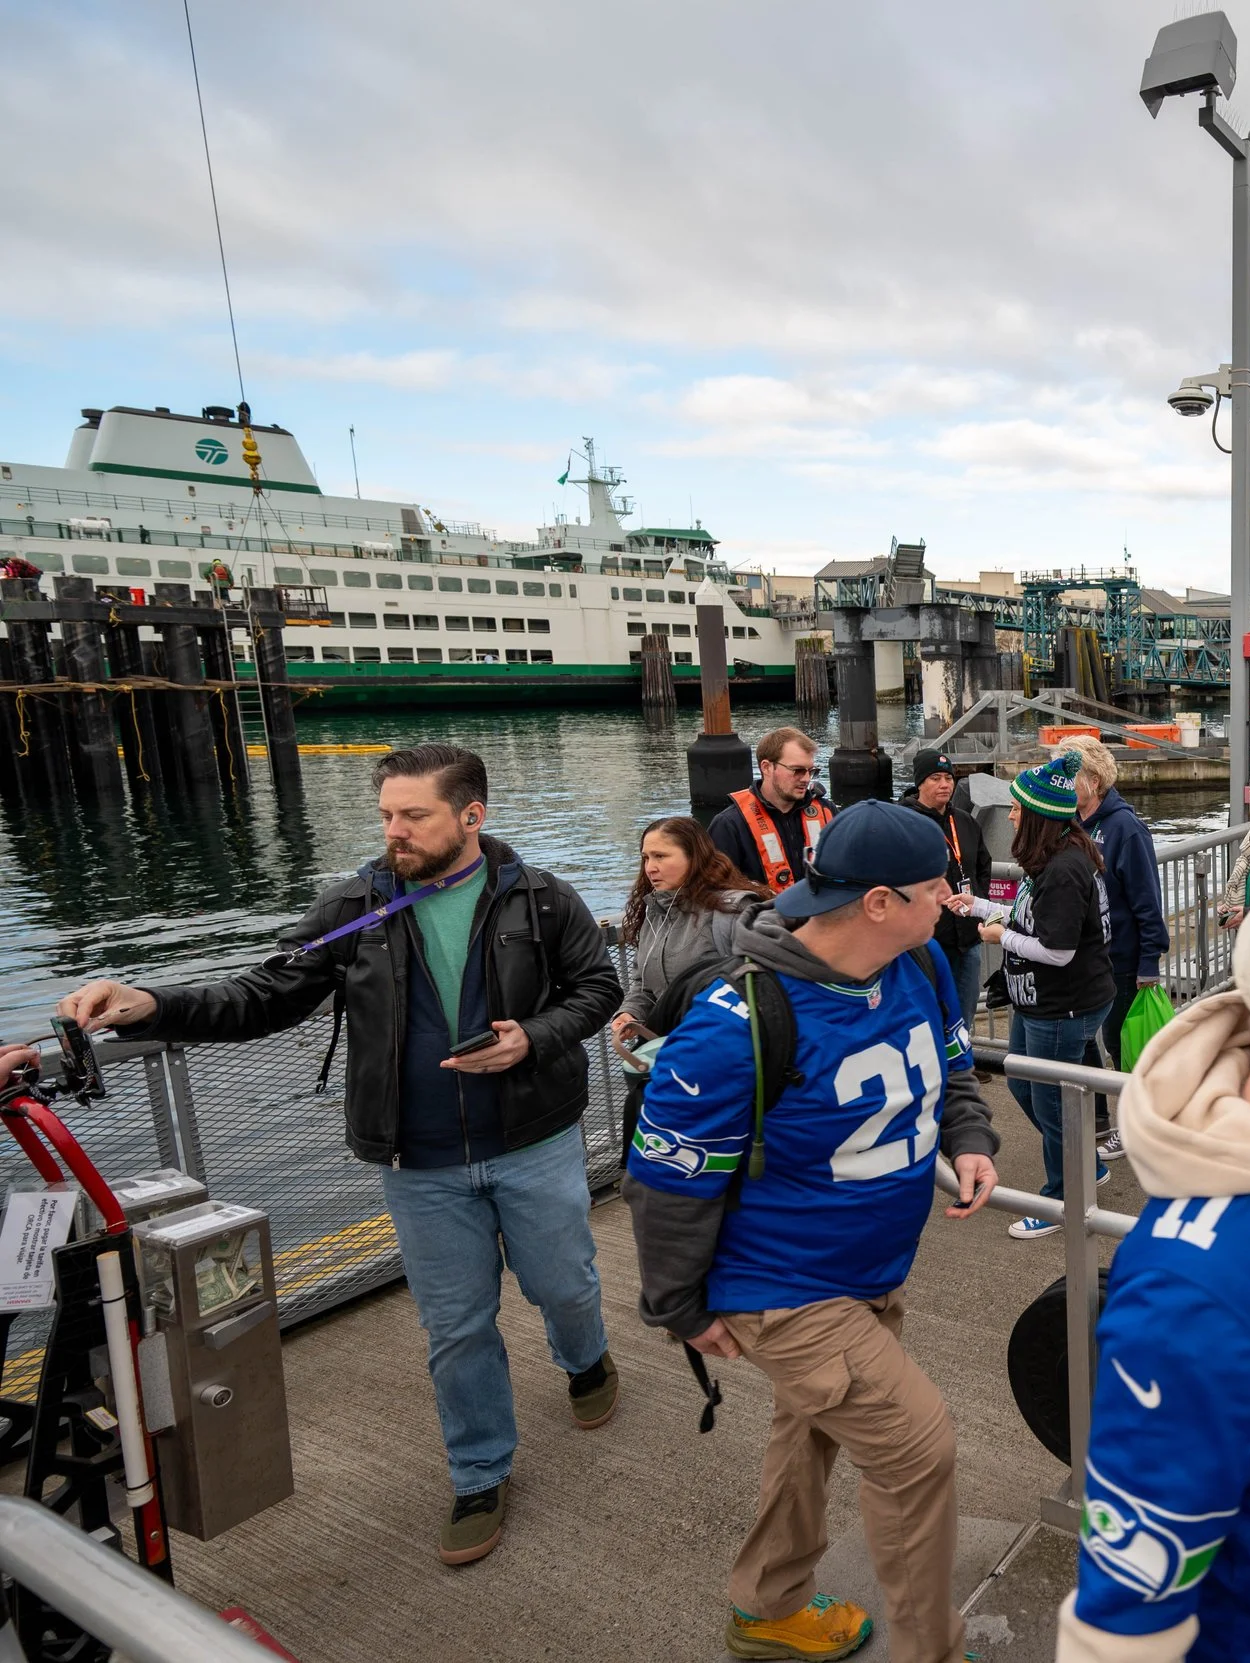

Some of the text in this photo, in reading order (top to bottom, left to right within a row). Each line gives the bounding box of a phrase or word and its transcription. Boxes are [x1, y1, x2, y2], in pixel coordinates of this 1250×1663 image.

[756, 816, 769, 831] VEST
[829, 1021, 943, 1183] 21
[37, 1198, 48, 1222] efectivo
[50, 1200, 58, 1210] Por
[25, 1214, 35, 1232] ORCA
[20, 1232, 30, 1245] para
[32, 1227, 41, 1251] mostrar
[41, 1228, 50, 1245] pagar
[24, 1250, 36, 1272] tarjeta
[36, 1251, 45, 1269] tarifa
[22, 1271, 31, 1280] de
[33, 1269, 40, 1278] en
